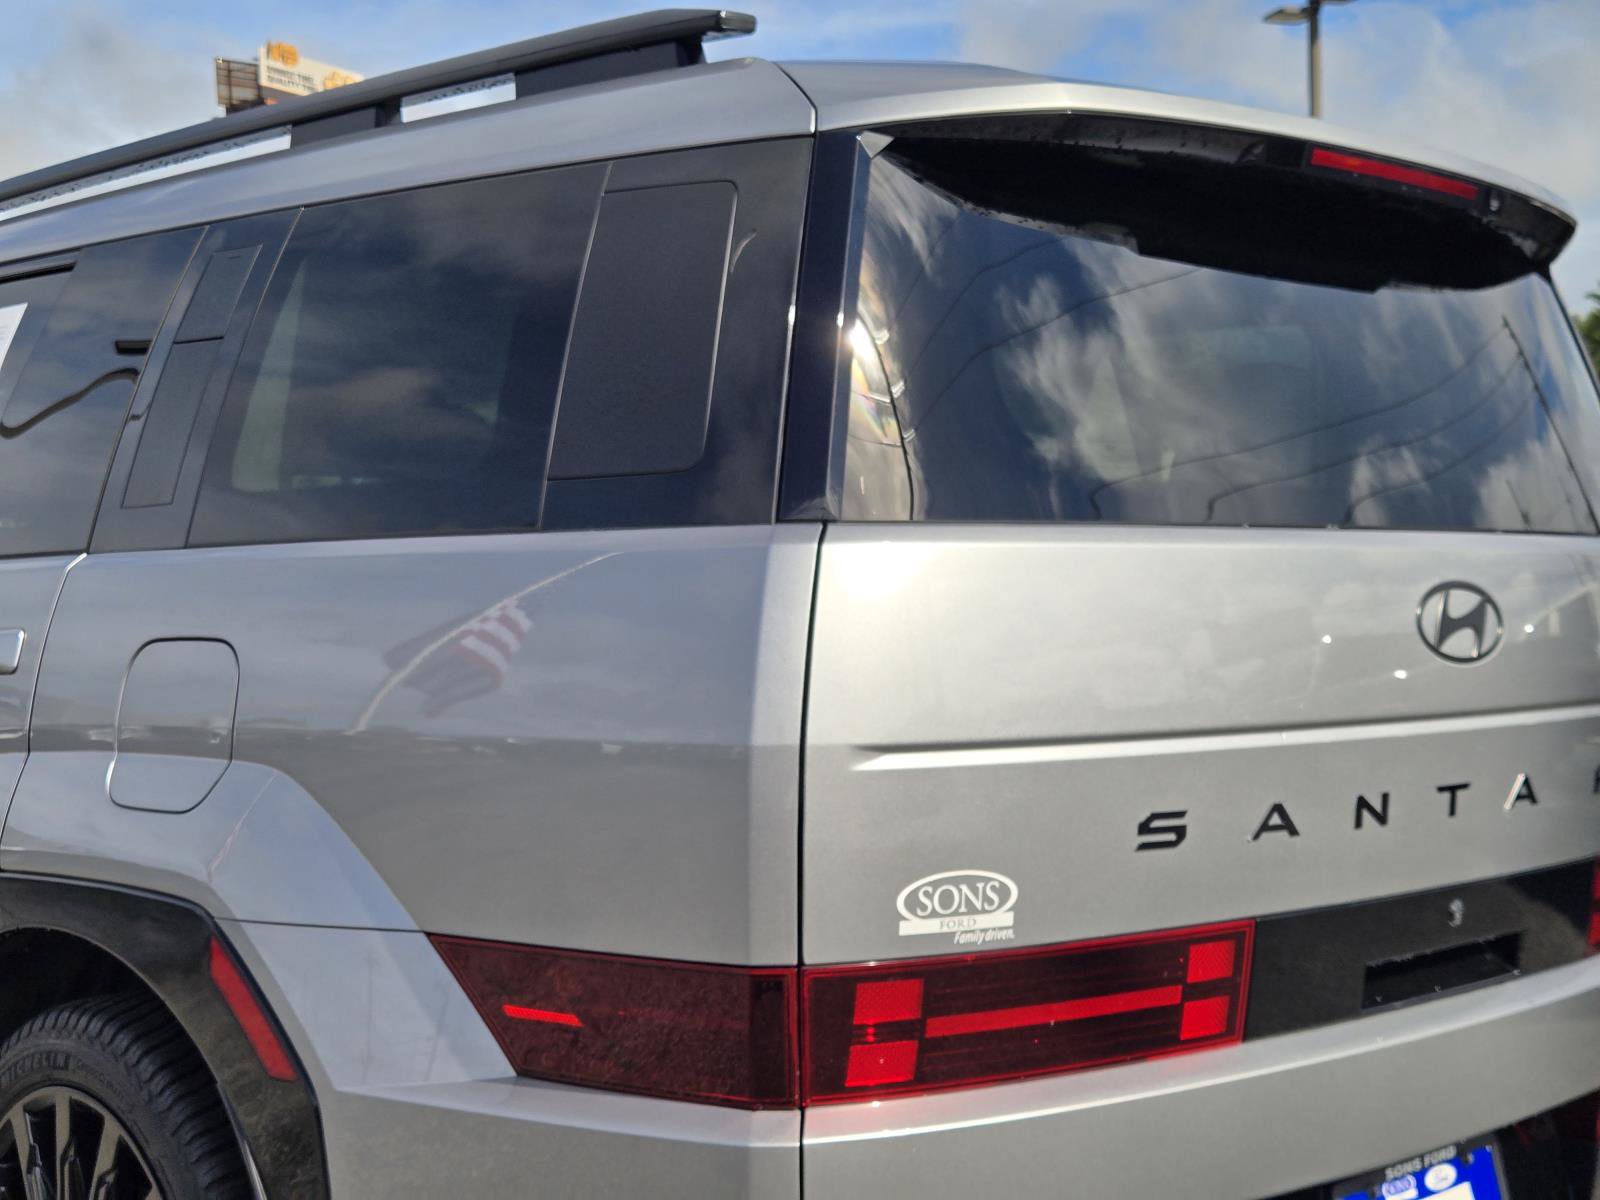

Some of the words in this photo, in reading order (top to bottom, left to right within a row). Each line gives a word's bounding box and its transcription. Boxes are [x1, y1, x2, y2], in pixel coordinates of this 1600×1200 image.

[1135, 773, 1538, 851] SANTA
[916, 880, 1000, 917] SONS
[939, 917, 977, 931] FORD
[954, 930, 985, 945] Family
[1385, 1157, 1423, 1181] SONS
[1423, 1145, 1457, 1168] FORD
